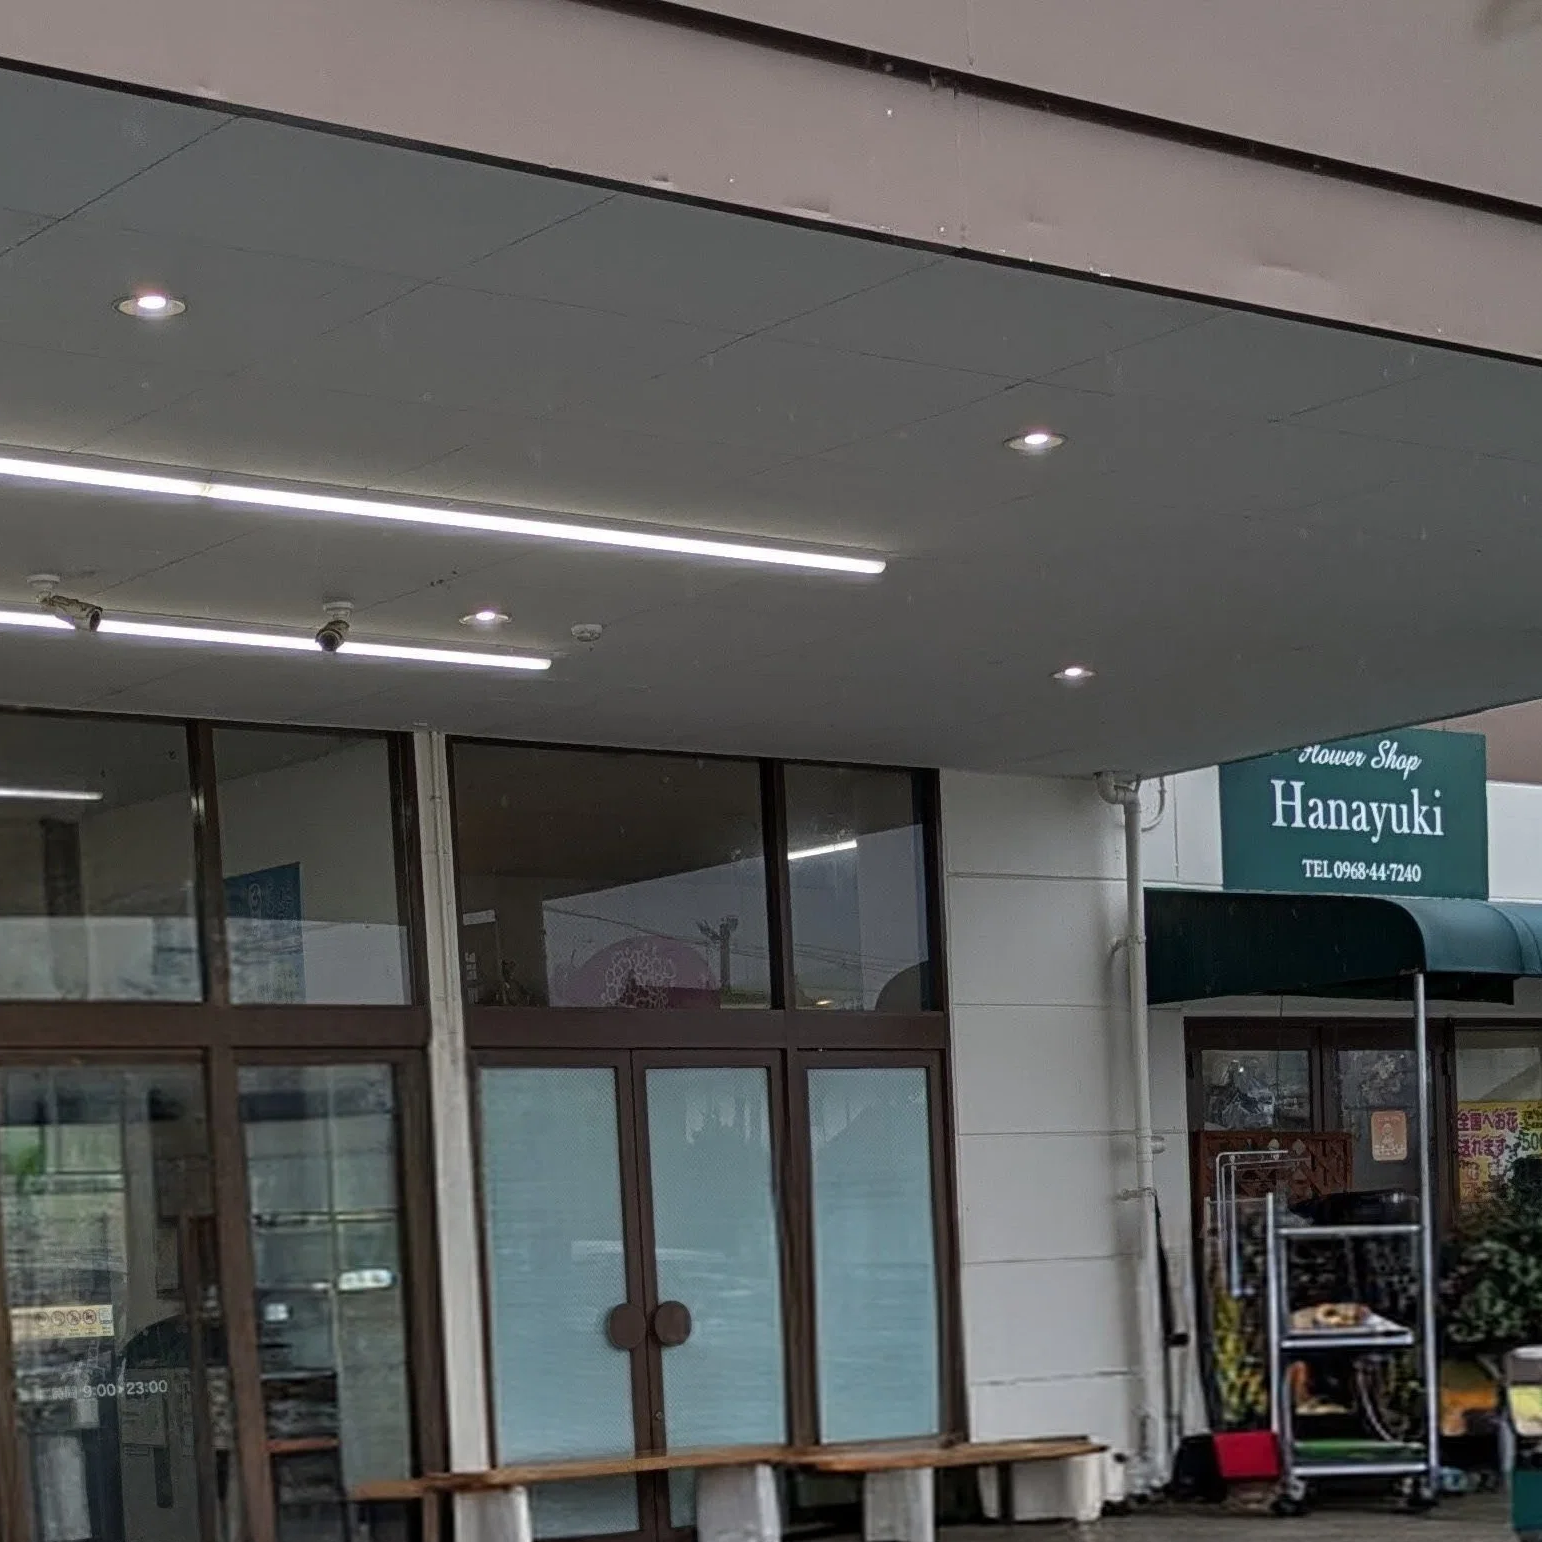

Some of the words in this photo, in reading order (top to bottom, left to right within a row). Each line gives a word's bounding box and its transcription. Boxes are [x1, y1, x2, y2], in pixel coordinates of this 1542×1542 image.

[1370, 739, 1422, 780] Shop
[1270, 778, 1445, 844] Hanayuki
[126, 1380, 169, 1395] 23:00
